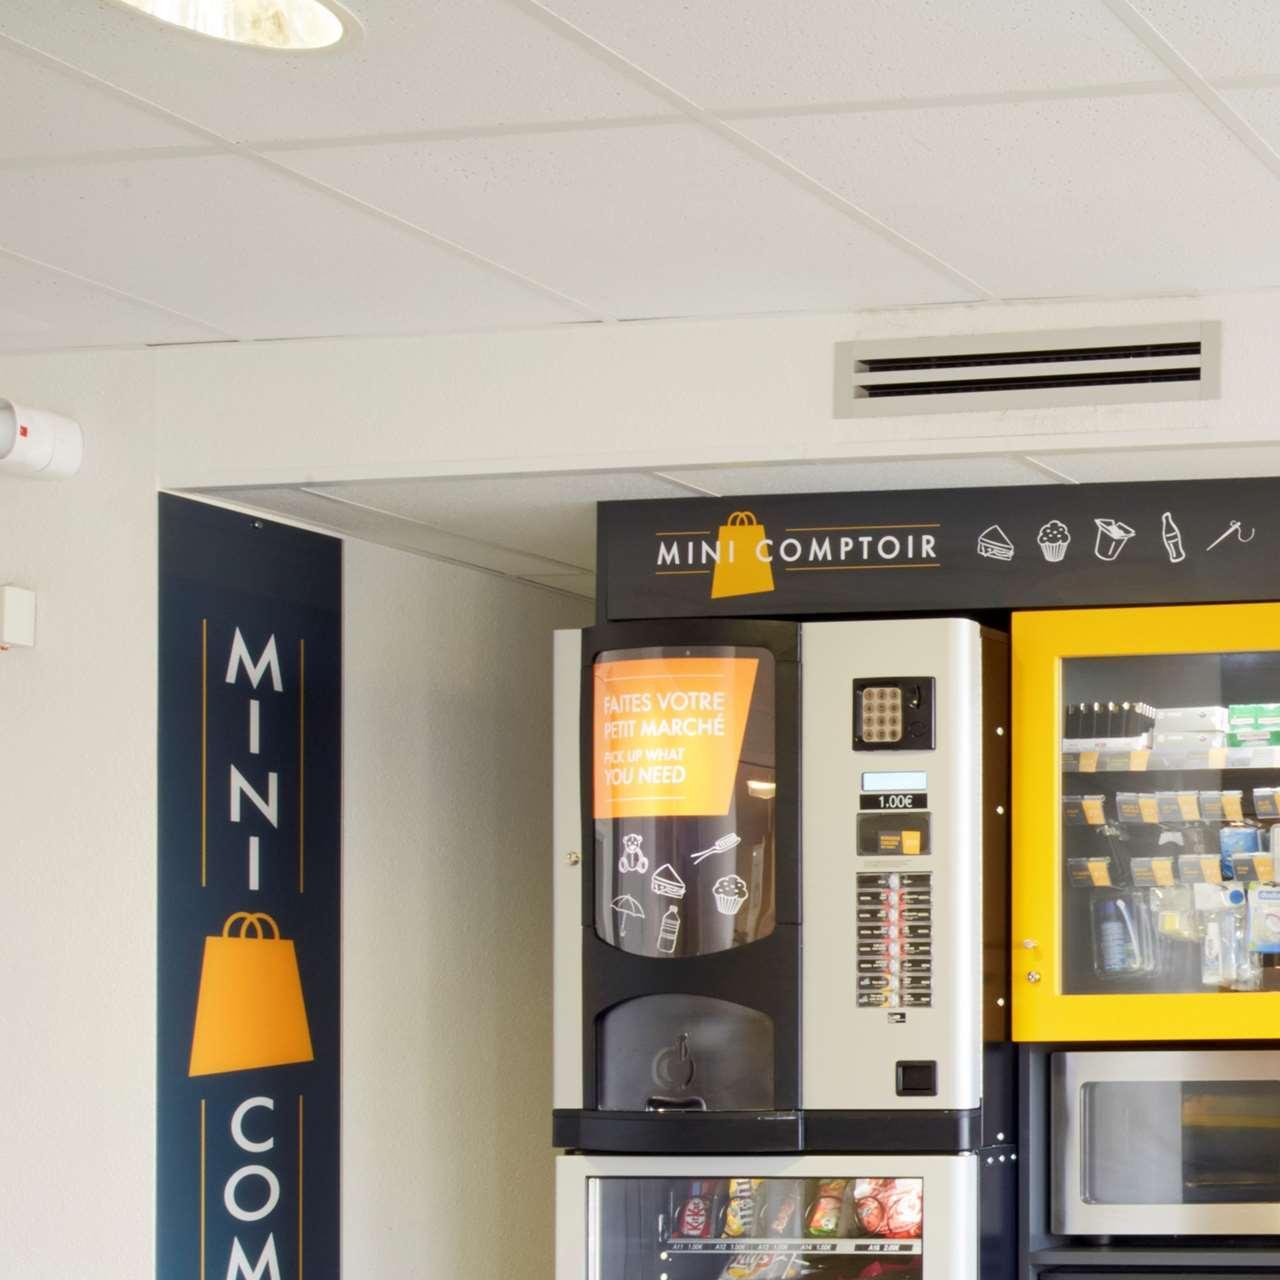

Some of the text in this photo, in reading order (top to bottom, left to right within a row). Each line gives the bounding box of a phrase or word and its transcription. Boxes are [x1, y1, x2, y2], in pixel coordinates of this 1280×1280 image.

[657, 535, 937, 565] MINI COMPTOIR
[603, 691, 726, 714] FAITES VOTRE
[603, 712, 726, 739] PETIT MARCHÉ
[225, 626, 284, 891] MINI
[603, 747, 686, 763] PICK UP WHAT
[603, 764, 687, 785] YOU NEED
[878, 795, 913, 808] 1.00€
